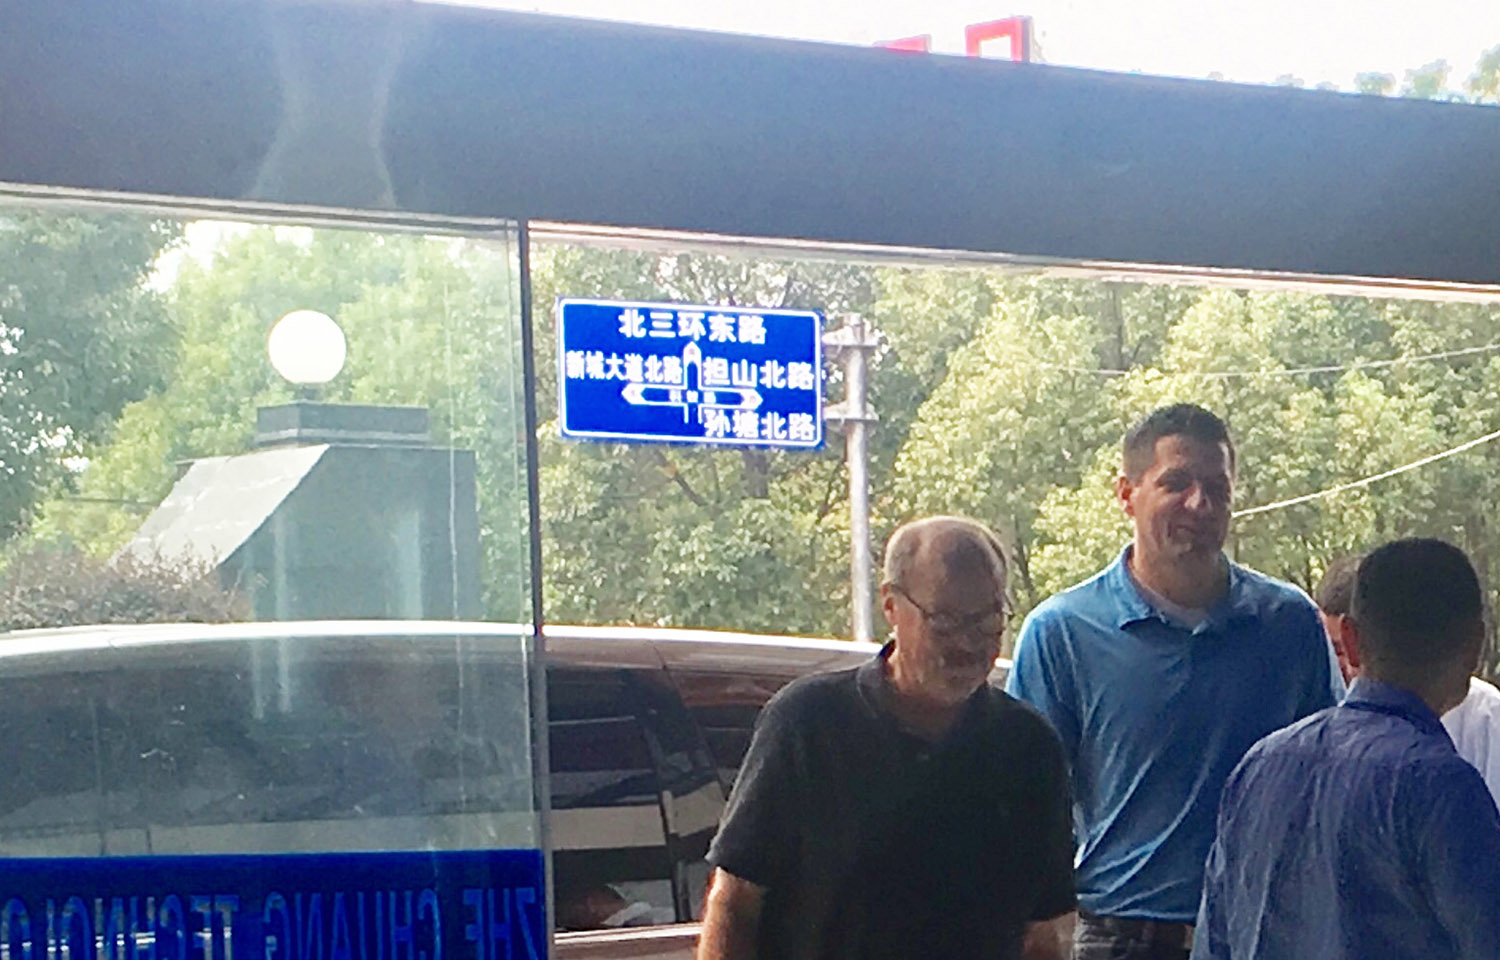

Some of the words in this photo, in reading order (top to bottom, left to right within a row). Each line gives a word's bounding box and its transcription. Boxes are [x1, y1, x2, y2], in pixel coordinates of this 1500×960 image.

[618, 308, 767, 344] 北三环东路
[566, 350, 683, 384] 新城大道北路
[704, 410, 815, 440] 孙塘北路
